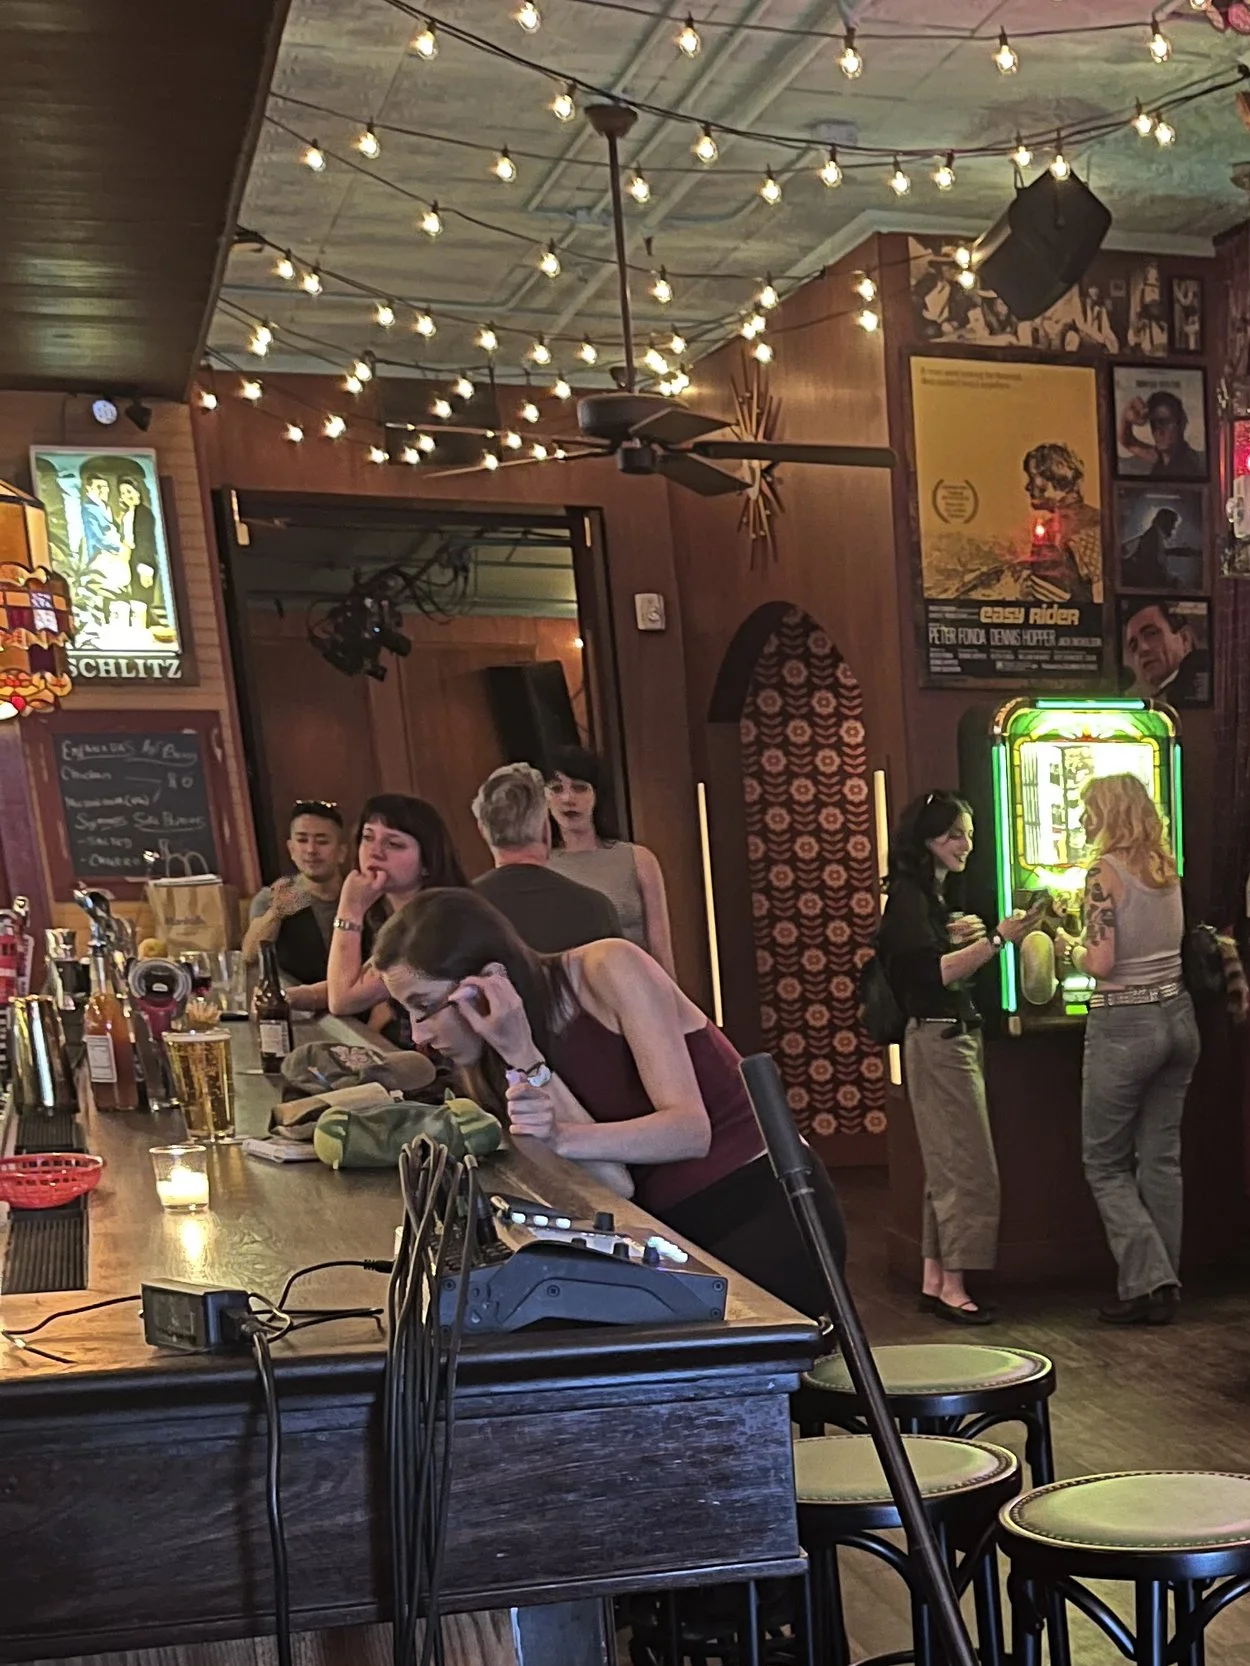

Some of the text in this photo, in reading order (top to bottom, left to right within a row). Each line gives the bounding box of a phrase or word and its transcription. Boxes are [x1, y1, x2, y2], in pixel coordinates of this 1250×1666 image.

[928, 627, 957, 645] PETER
[958, 628, 987, 646] FONDA
[989, 628, 1022, 646] DENNIS
[1023, 629, 1056, 647] HOPPER
[67, 658, 182, 679] SCHLITZ
